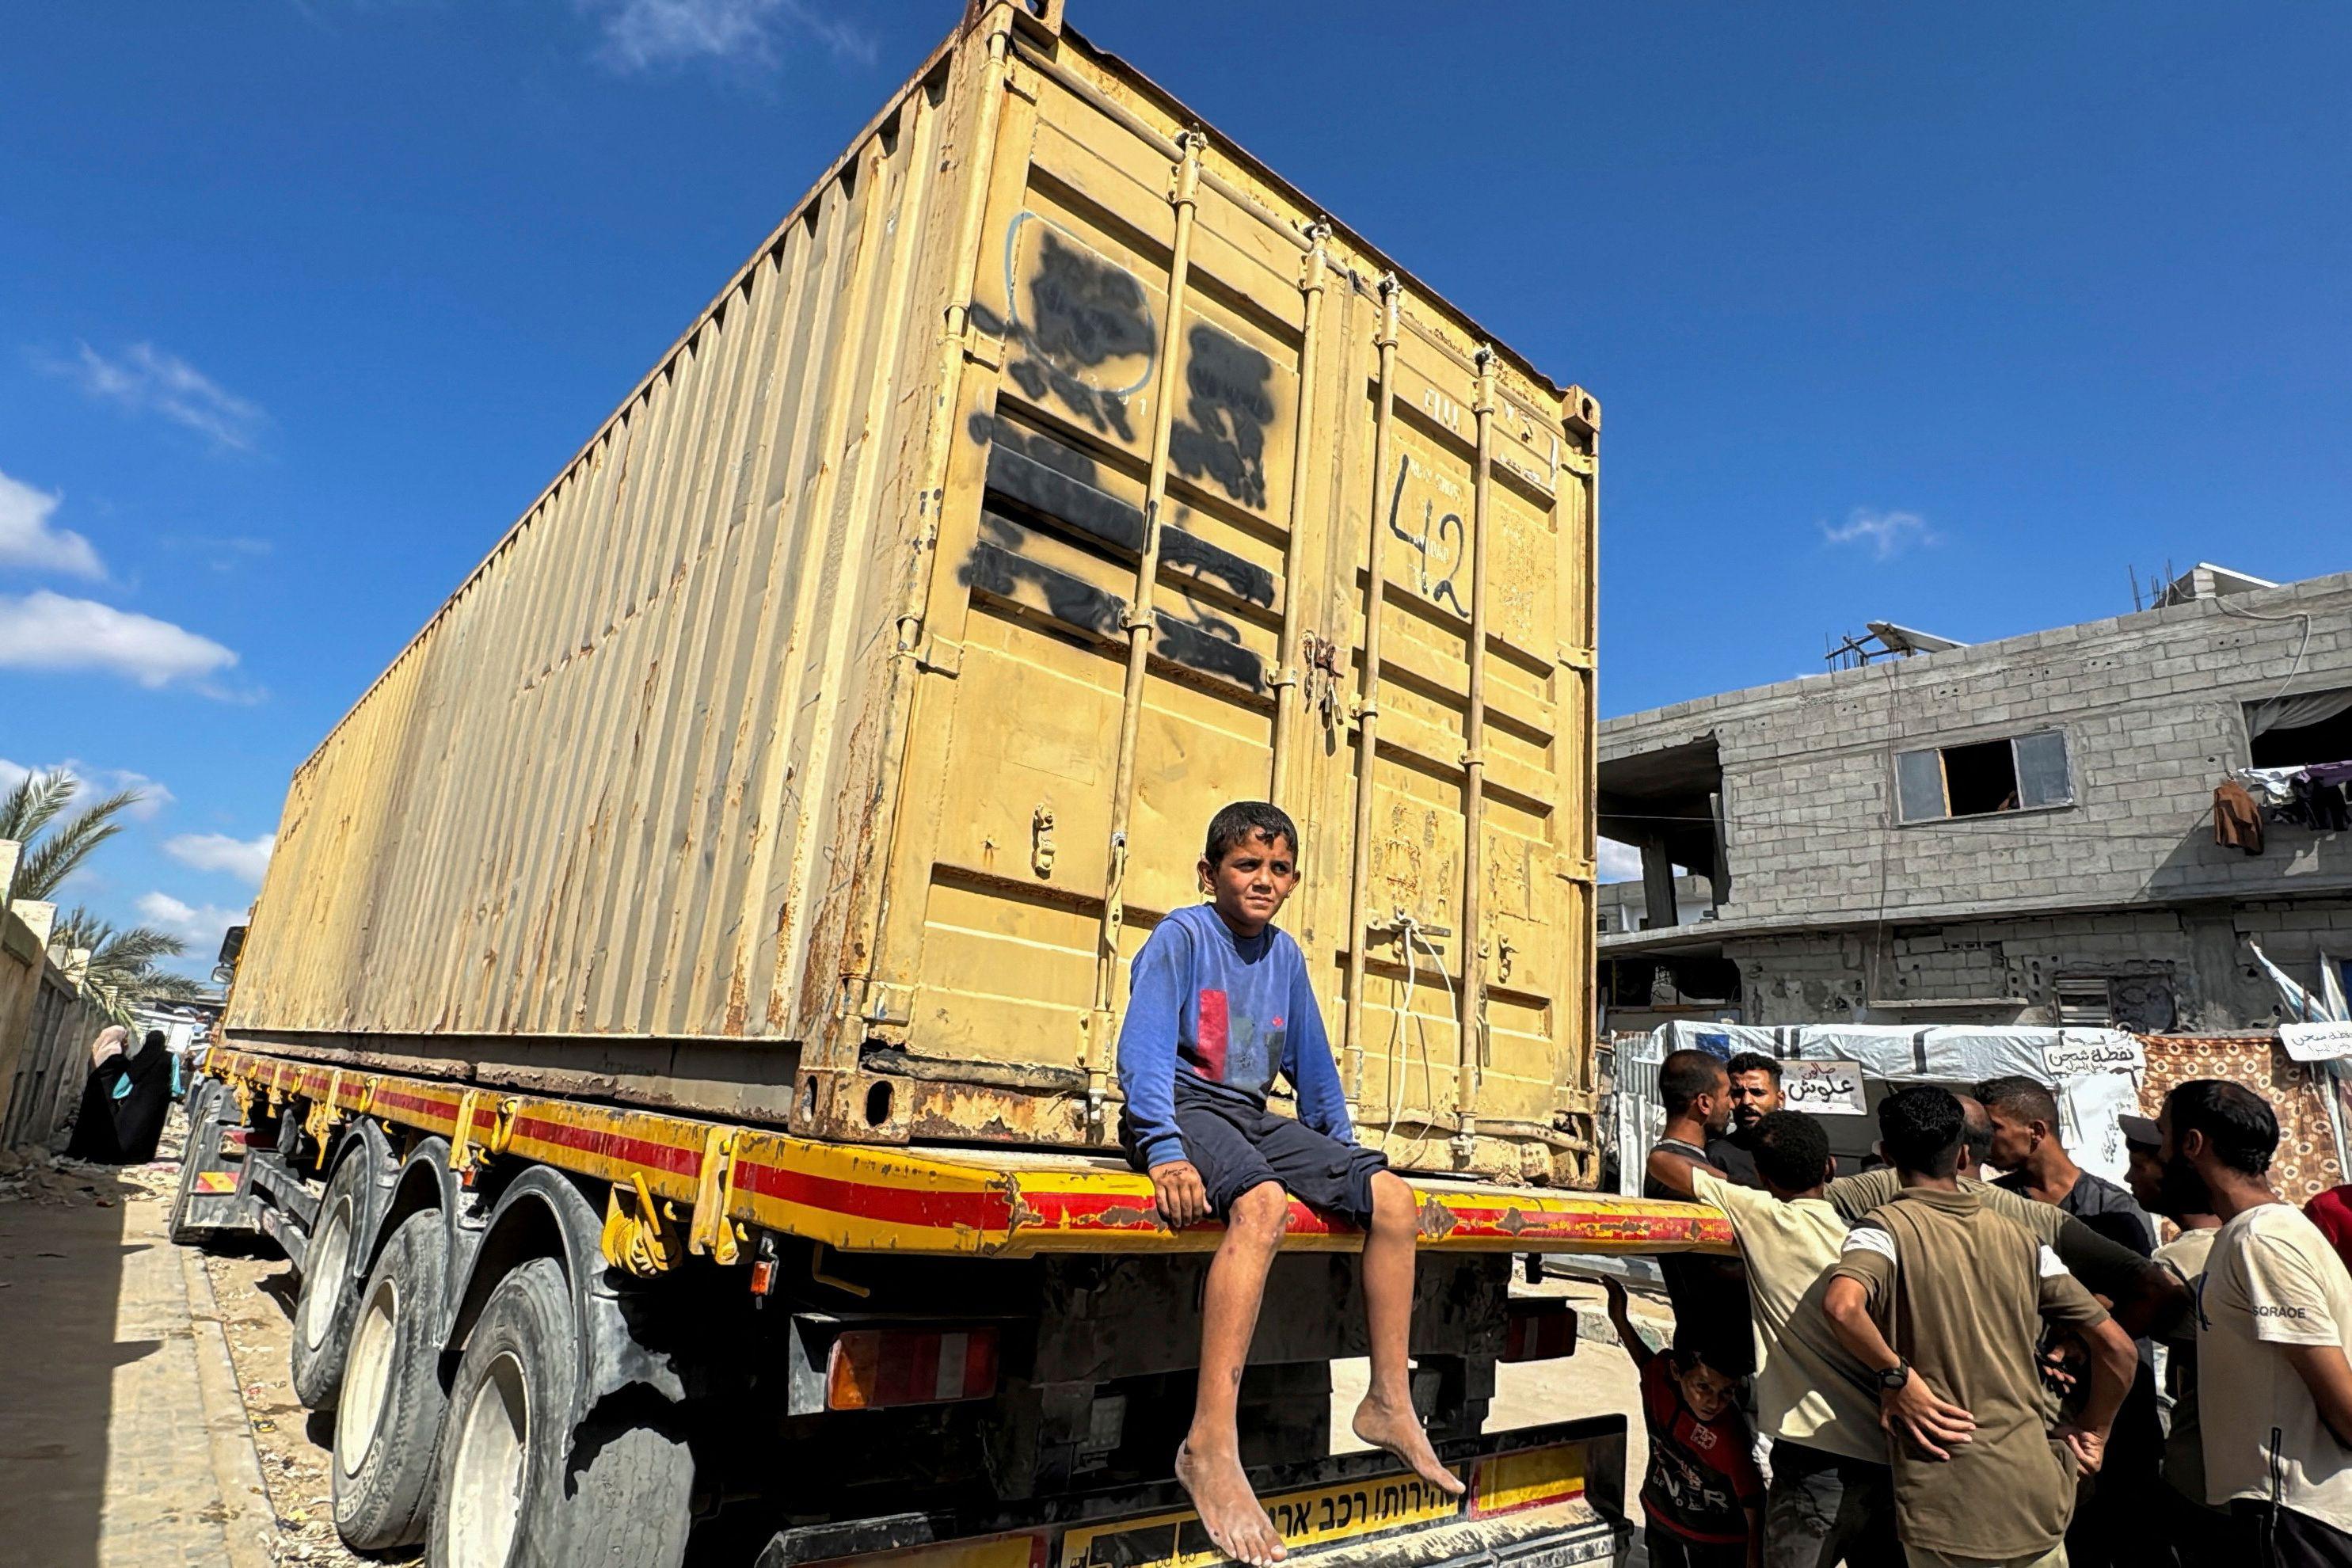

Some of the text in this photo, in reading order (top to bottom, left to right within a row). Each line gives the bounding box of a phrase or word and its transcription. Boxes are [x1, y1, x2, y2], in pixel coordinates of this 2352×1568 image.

[2049, 1046, 2135, 1067] نقطة شحن
[1801, 1062, 1836, 1080] صالون
[1788, 1075, 1855, 1103] علوش
[1319, 1491, 1368, 1532] רכב
